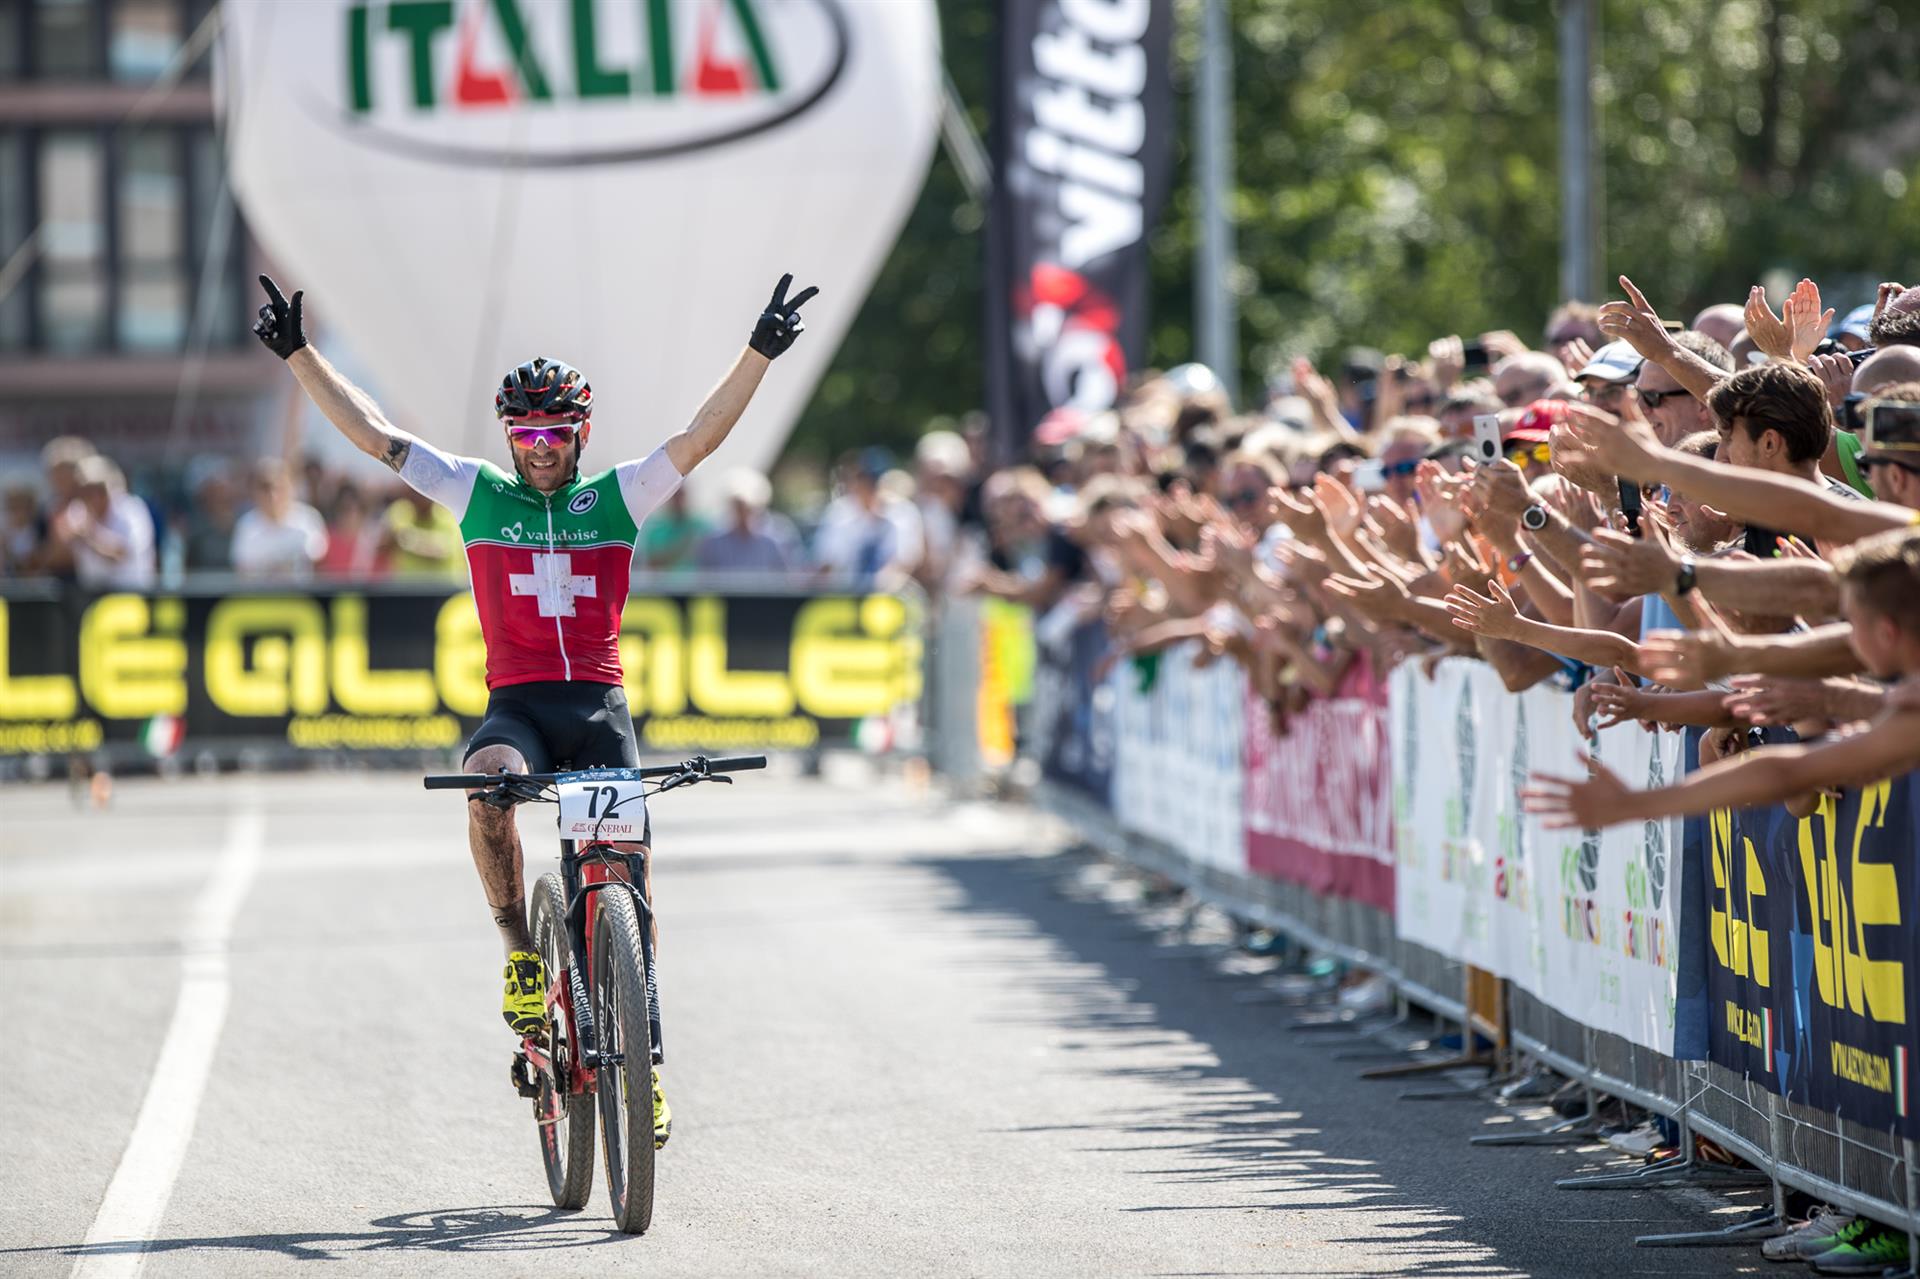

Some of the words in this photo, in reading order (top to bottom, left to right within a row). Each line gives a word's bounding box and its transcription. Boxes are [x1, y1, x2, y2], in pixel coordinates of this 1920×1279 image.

[347, 0, 783, 113] ITALIA
[526, 529, 599, 541] vaudoise
[583, 786, 619, 819] 72
[587, 823, 633, 834] GENERALI
